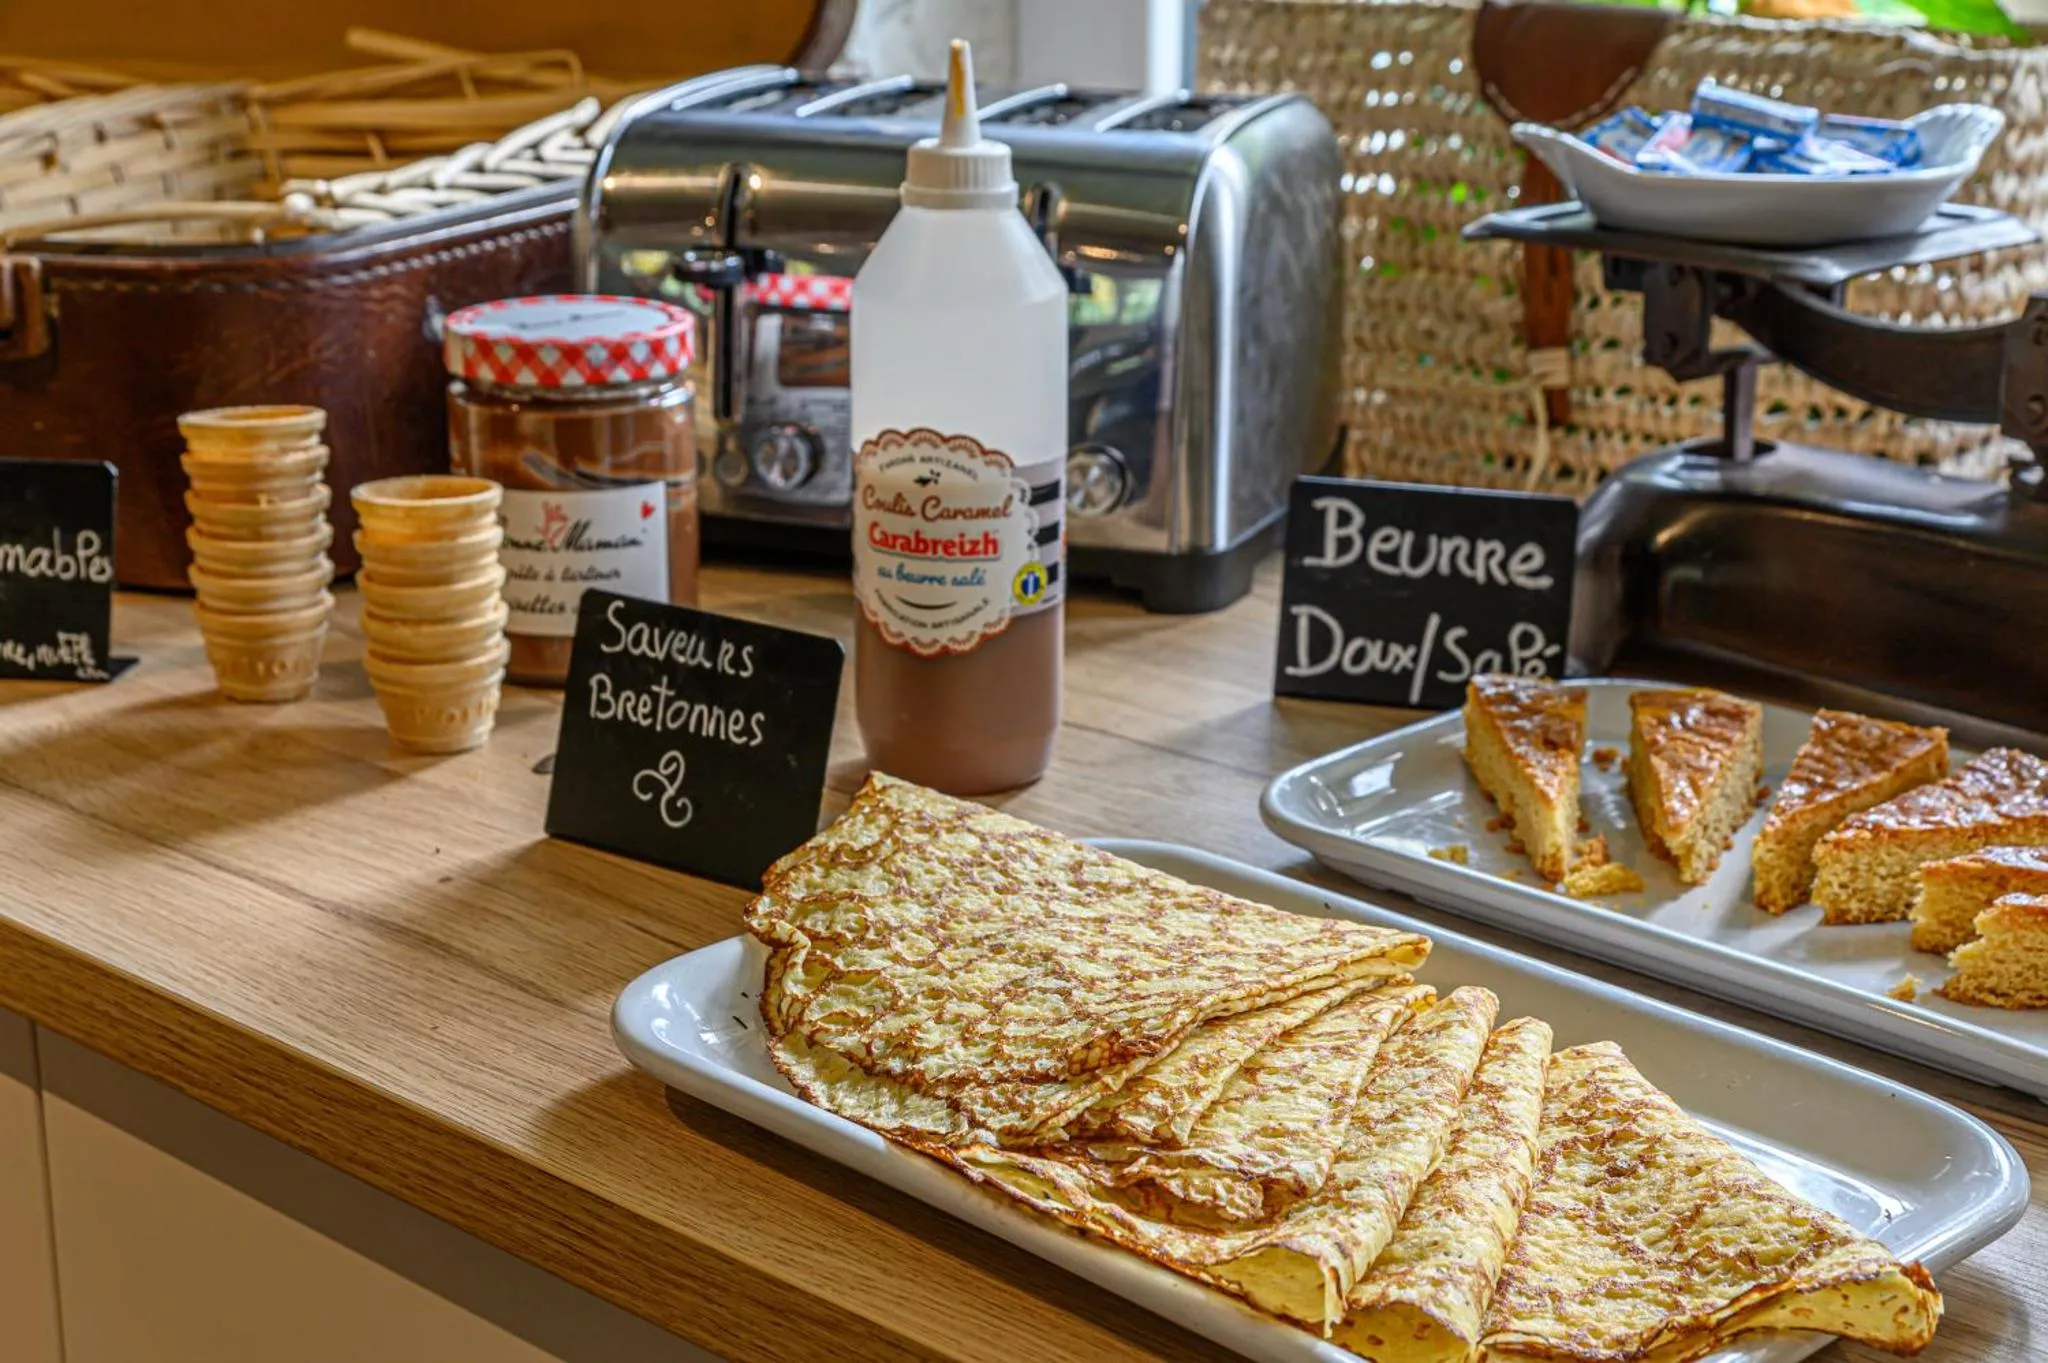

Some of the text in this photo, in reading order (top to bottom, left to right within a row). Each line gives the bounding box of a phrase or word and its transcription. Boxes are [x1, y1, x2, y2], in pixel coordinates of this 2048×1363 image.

[868, 521, 998, 557] Carabreizh
[921, 494, 1013, 522] Caramel
[1302, 497, 1555, 589] Beurre
[601, 600, 754, 677] Saveurs
[589, 673, 766, 746] Bretonnes
